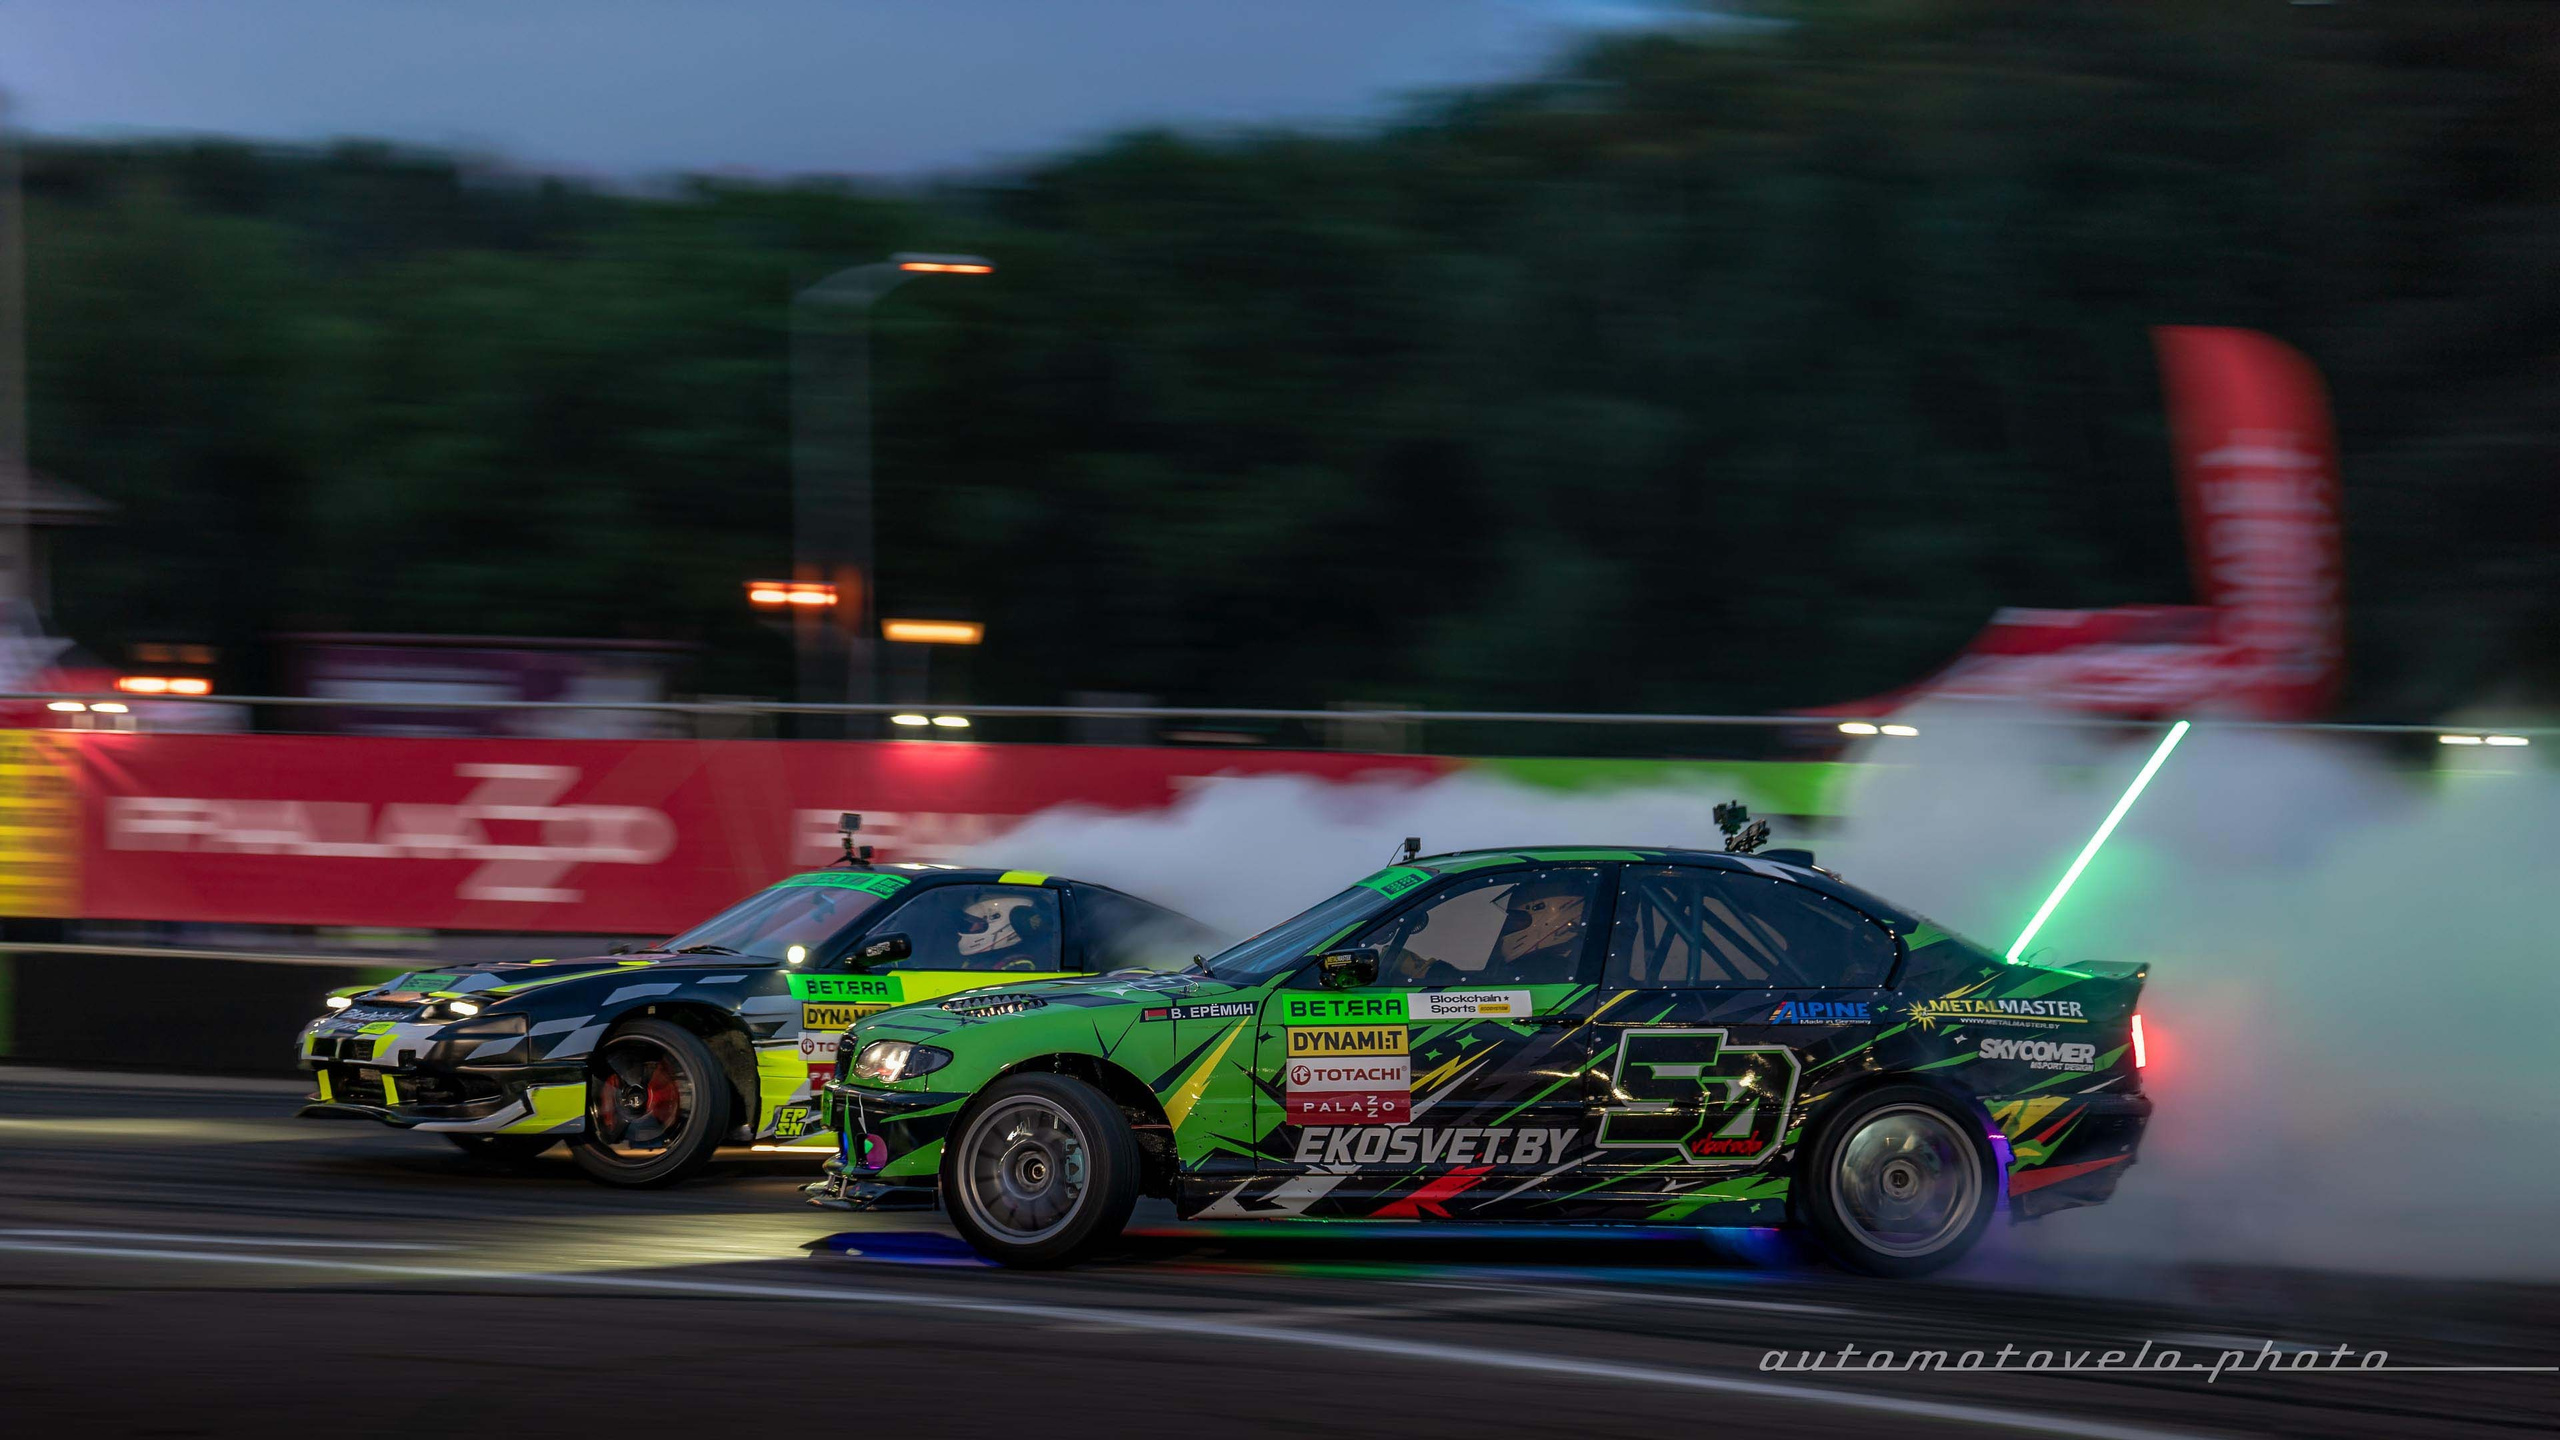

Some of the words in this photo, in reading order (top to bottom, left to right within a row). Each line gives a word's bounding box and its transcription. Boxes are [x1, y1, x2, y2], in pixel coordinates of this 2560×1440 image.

[1430, 994, 1502, 1004] Blockchain
[1171, 1007, 1186, 1019] В.
[1190, 1003, 1254, 1018] ЕРЁМИН
[1431, 1004, 1476, 1014] Sports
[1771, 1000, 1871, 1025] ALPINE
[1927, 999, 2084, 1018] METALMASTER
[1960, 1018, 2060, 1030] WWW.METALMASTER.BY
[1978, 1038, 2096, 1064] SKYCOMER
[1314, 1068, 1401, 1081] TOTACHI
[1294, 1126, 1580, 1165] EKOSVET.BY
